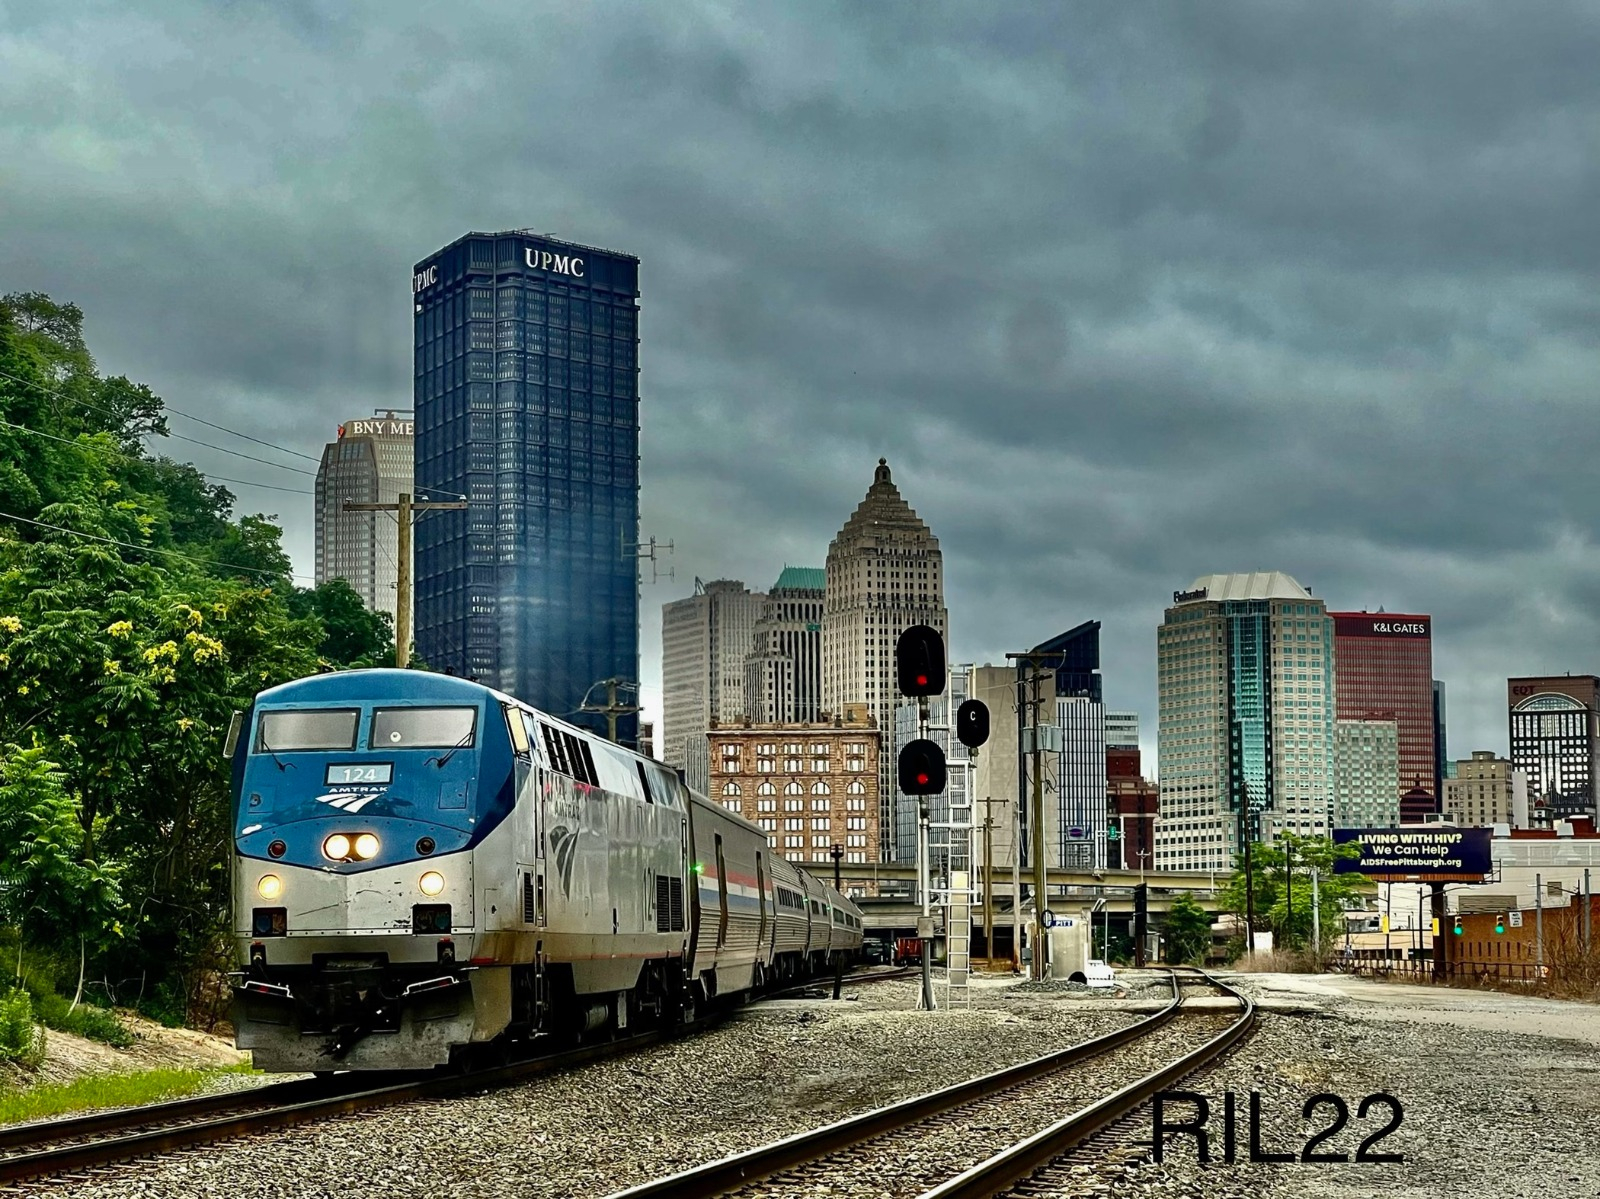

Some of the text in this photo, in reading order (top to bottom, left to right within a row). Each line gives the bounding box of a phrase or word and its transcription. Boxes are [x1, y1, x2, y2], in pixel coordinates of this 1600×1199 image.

[525, 247, 584, 277] UPMC
[411, 265, 438, 294] UPMC
[353, 421, 386, 434] BNY
[1373, 622, 1425, 634] K&L GATES
[1512, 685, 1537, 696] EQT
[970, 711, 976, 721] C
[343, 767, 377, 782] 124
[328, 786, 388, 794] AMTRAK
[1358, 833, 1463, 844] LIVING WITH HIV?
[1372, 845, 1449, 857] We Can Help
[1360, 858, 1462, 868] AIDSFreePittsburgh.org
